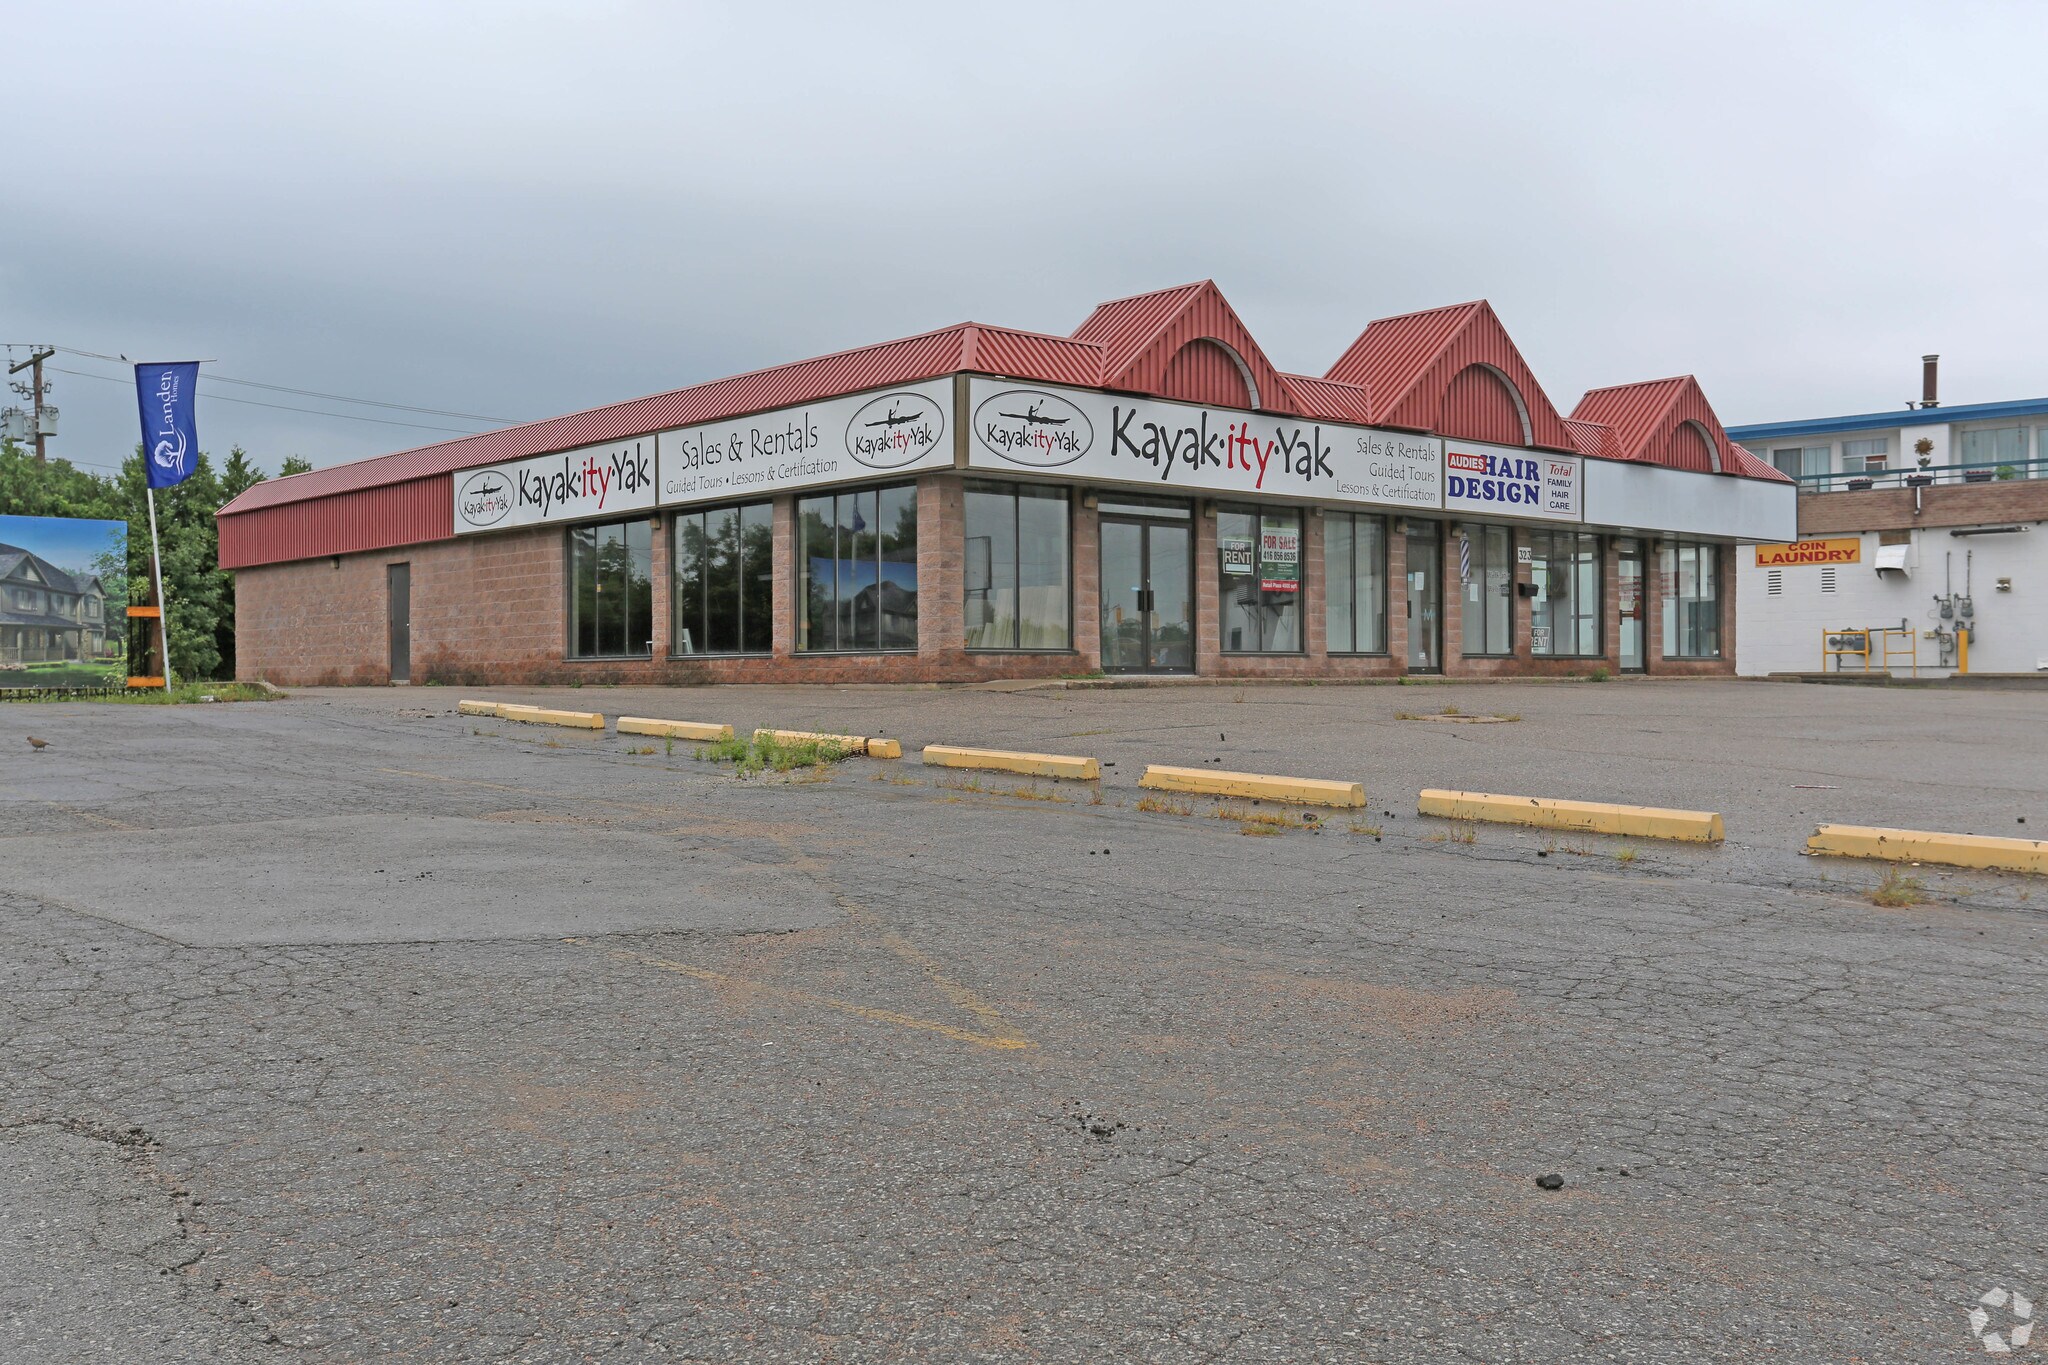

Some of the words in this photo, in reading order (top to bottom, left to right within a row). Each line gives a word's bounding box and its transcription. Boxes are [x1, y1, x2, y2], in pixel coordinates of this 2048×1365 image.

[171, 375, 180, 402] Homes
[156, 370, 175, 437] Landen
[681, 431, 722, 470] Sales
[728, 432, 743, 463] &
[750, 411, 818, 458] Rentals
[1356, 435, 1382, 455] Sales
[1384, 441, 1395, 458] &
[1398, 442, 1436, 462] Rentals
[1449, 455, 1485, 470] AUDIES
[1480, 454, 1540, 482] HAIR
[1550, 463, 1573, 477] Total
[666, 475, 696, 495] Guided
[698, 473, 723, 490] Tours
[731, 468, 764, 487] Lessons
[767, 466, 775, 481] &
[778, 456, 838, 479] Certification
[1369, 462, 1405, 481] Guided
[1408, 466, 1436, 483] Tours
[1336, 479, 1370, 496] Lessons
[1371, 483, 1380, 497] &
[1381, 483, 1436, 502] Certification
[1448, 475, 1540, 505] DESIGN
[1547, 478, 1573, 488] FAMILY
[1551, 490, 1569, 499] HAIR
[1549, 501, 1570, 510] CARE
[1230, 542, 1245, 551] FOR
[1263, 535, 1277, 549] FOR
[1279, 536, 1296, 550] SALE
[1788, 542, 1826, 552] COIN
[1224, 550, 1251, 564] RENT
[1263, 550, 1273, 561] 416
[1518, 550, 1532, 561] 323
[1758, 549, 1856, 564] LAUNDRY
[1533, 628, 1545, 637] FOR
